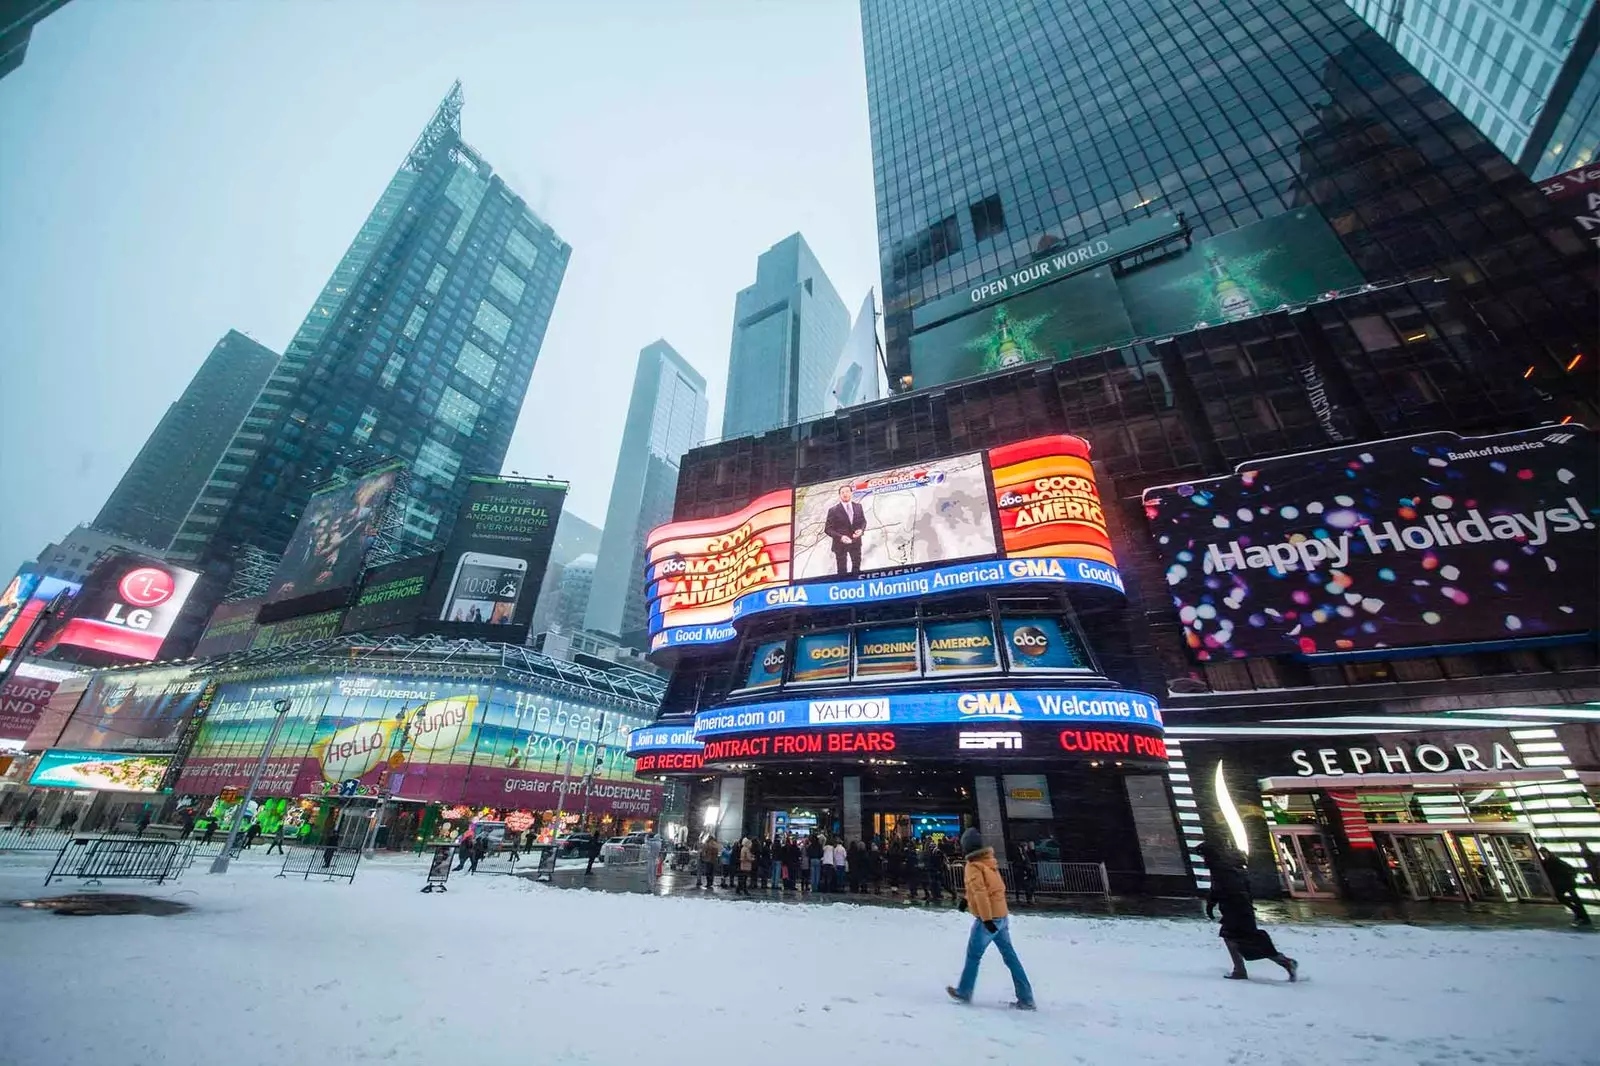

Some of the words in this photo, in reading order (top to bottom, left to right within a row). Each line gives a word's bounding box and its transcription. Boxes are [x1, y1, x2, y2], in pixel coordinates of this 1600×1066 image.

[971, 280, 1008, 302] OPEN
[1010, 262, 1051, 287] YOUR
[1052, 240, 1113, 270] WORLD.
[1448, 449, 1476, 461] Bank
[1475, 447, 1492, 457] of
[1492, 441, 1545, 454] America
[1034, 476, 1092, 493] GOOD
[471, 502, 548, 517] BEAUTIFUL
[510, 497, 536, 506] MOST
[999, 495, 1023, 507] abc
[465, 512, 512, 523] ANDROID
[514, 516, 548, 527] PHONE
[475, 522, 502, 531] EVER
[1207, 535, 1349, 575] Happy
[1360, 497, 1596, 555] Holidays!
[661, 560, 686, 574] abc
[765, 587, 809, 605] GMA
[829, 585, 865, 601] Good
[869, 573, 929, 598] Morning
[933, 563, 1005, 587] America!
[1008, 560, 1066, 578] GMA
[1078, 562, 1113, 584] Good
[358, 584, 424, 607] SMARTPHONE
[105, 603, 152, 630] LG
[675, 629, 703, 641] Good
[763, 654, 785, 667] abc
[811, 646, 850, 661] GOOD
[931, 636, 993, 651] AMERICA
[1013, 632, 1048, 647] abc
[371, 689, 437, 701] LAUDERDALE
[515, 691, 552, 723] the
[556, 700, 612, 737] beach
[768, 710, 785, 724] on
[814, 701, 885, 721] YAHOO!
[958, 693, 1022, 715] GMA
[1037, 695, 1131, 717] Welcome
[1132, 700, 1148, 718] to
[524, 733, 580, 758] good
[636, 732, 654, 748] Join
[655, 733, 668, 745] us
[704, 736, 769, 760] CONTRACT
[774, 733, 823, 753] FROM
[828, 731, 896, 752] BEARS
[959, 732, 1023, 749] ESPN
[1060, 730, 1129, 753] CURRY
[1291, 742, 1523, 777] SEPHORA
[504, 778, 552, 792] greater
[611, 801, 651, 813] sunny.org
